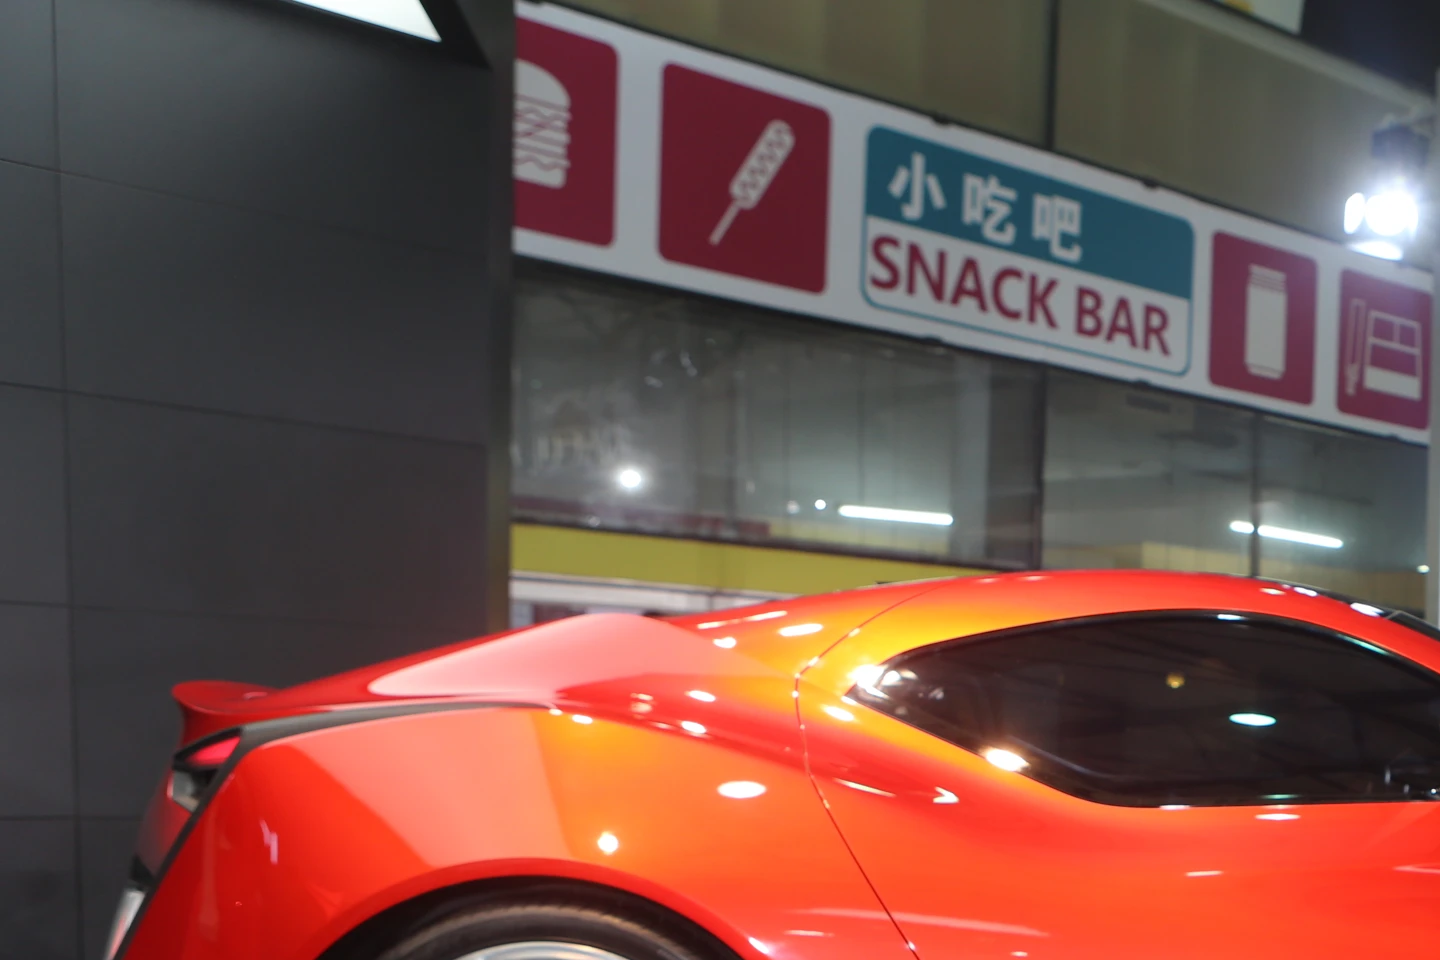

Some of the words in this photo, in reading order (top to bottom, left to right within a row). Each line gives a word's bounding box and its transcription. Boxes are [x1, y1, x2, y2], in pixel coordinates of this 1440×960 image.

[888, 151, 1083, 263] 小吃吧
[870, 234, 1059, 330] SNACK
[1074, 284, 1171, 357] BAR
